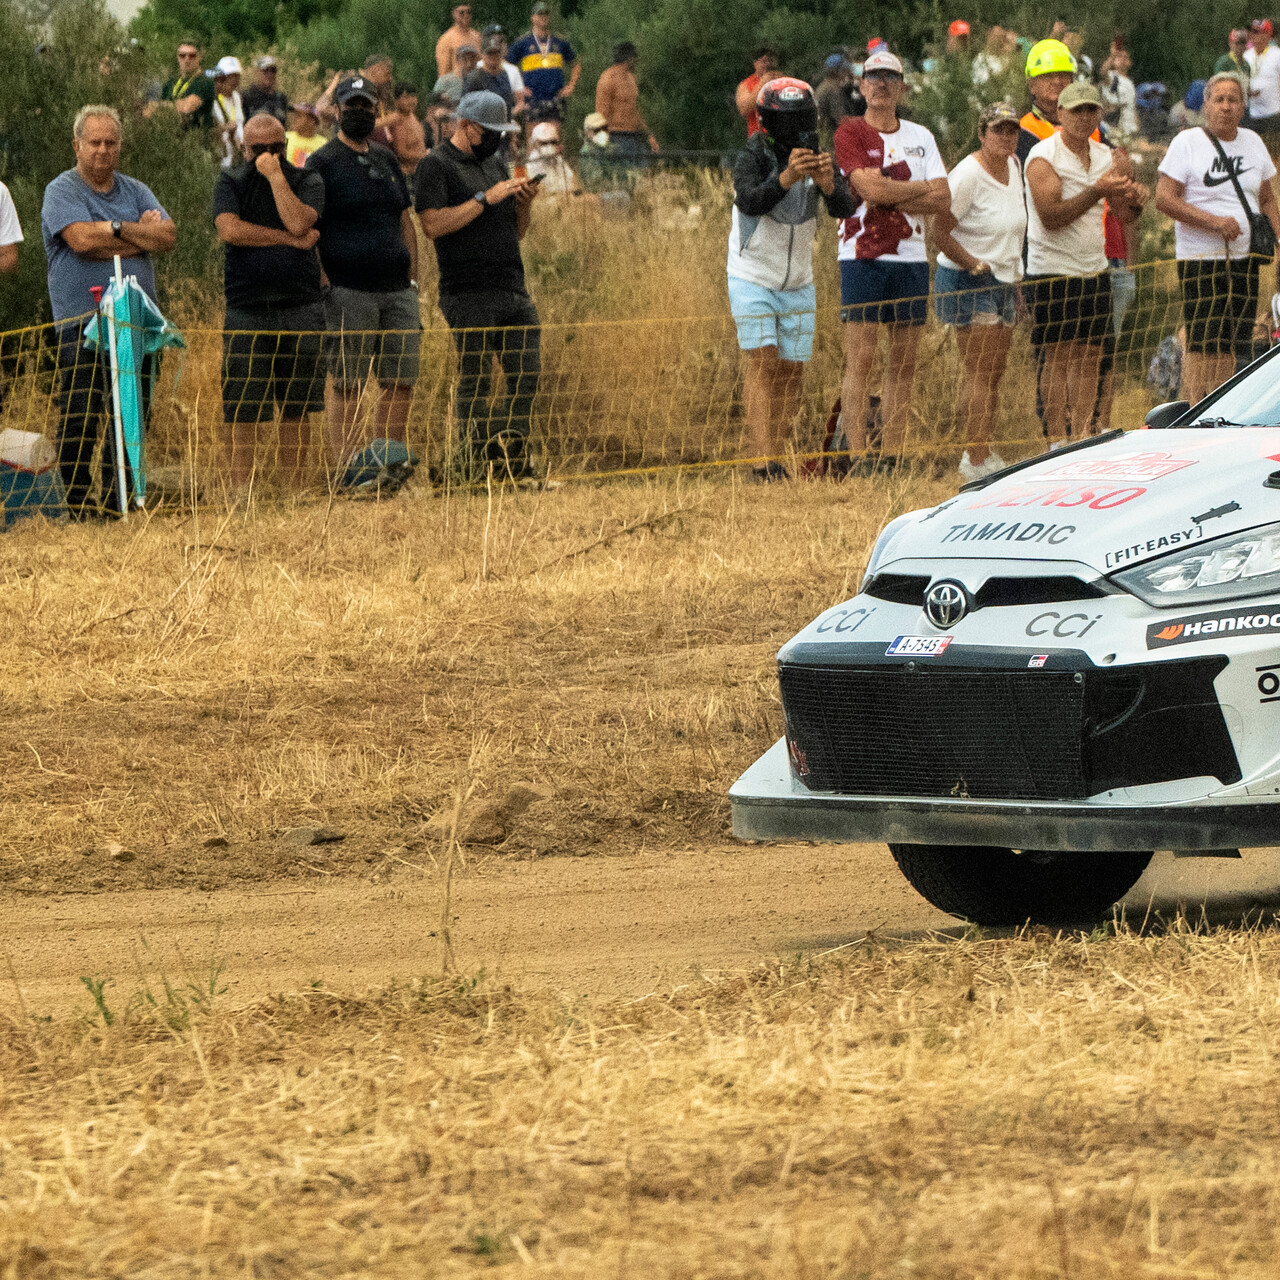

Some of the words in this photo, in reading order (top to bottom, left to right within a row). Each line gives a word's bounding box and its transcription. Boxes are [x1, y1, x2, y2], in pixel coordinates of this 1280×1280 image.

[964, 486, 1148, 511] DENSO
[940, 522, 1077, 545] TAMADIC
[899, 638, 940, 652] A-7545
